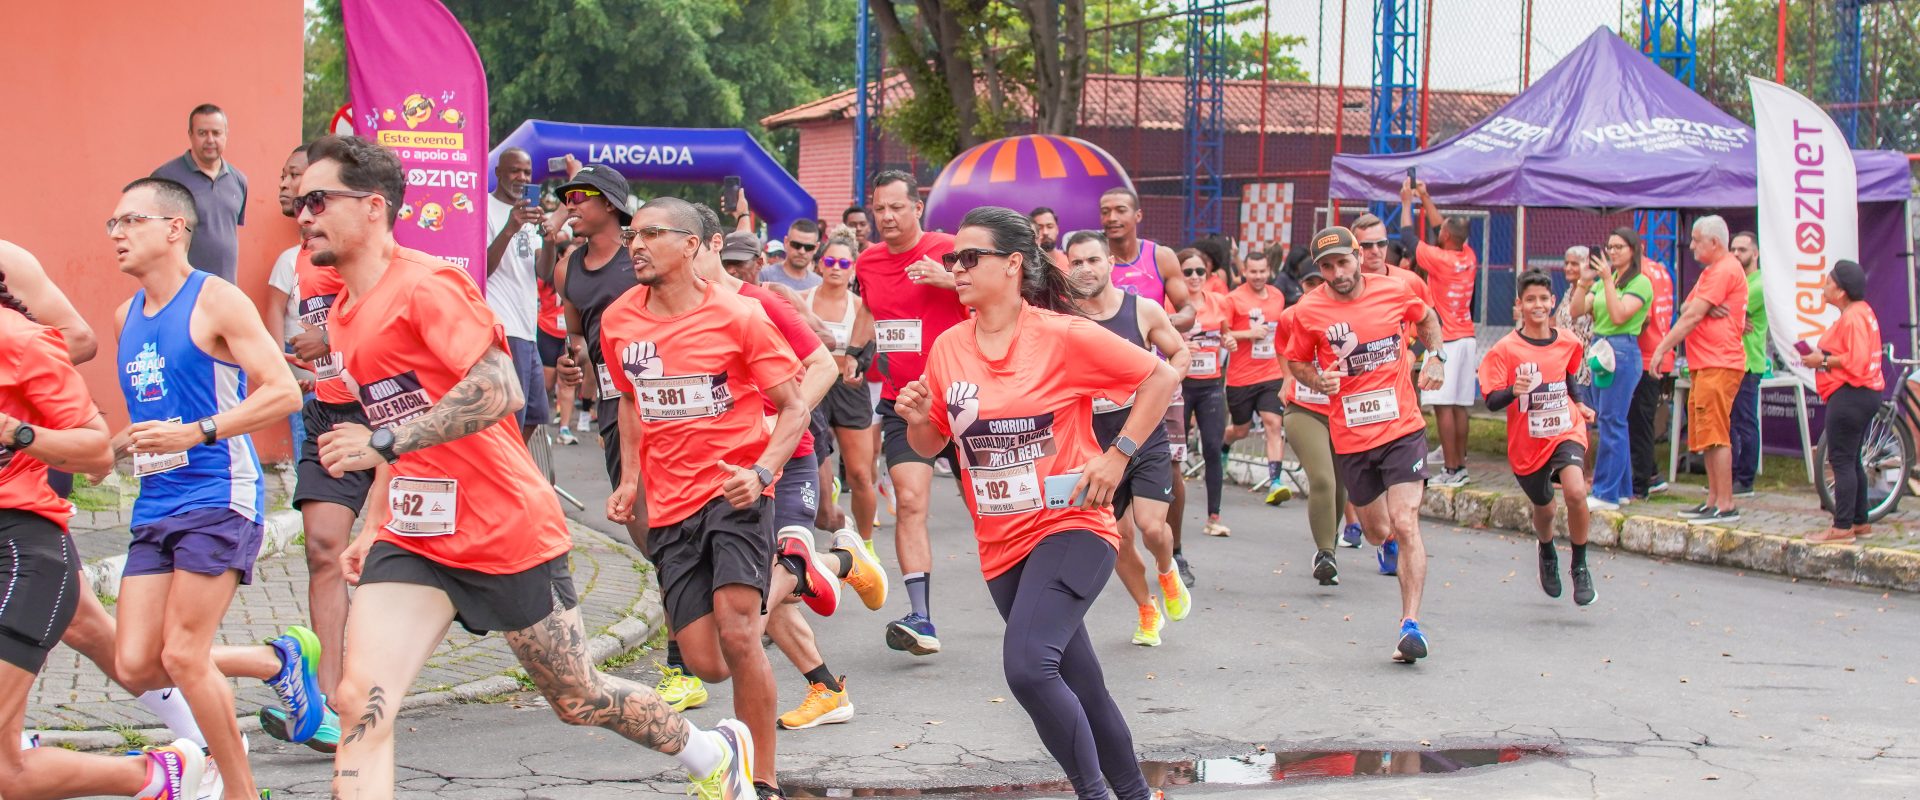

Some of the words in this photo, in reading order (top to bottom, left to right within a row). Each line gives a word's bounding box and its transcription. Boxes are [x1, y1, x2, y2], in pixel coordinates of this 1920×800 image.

[383, 133, 409, 143] Este
[413, 136, 457, 146] evento
[402, 150, 410, 159] o
[413, 150, 449, 162] apoio
[452, 150, 467, 161] da
[588, 144, 694, 165] LARGADA
[886, 328, 905, 341] 356
[657, 388, 686, 406] 381
[1359, 399, 1381, 414] 426
[989, 418, 1036, 434] CORRIDA
[1542, 416, 1560, 429] 239
[1017, 443, 1045, 461] REAL
[985, 480, 1011, 500] 192
[402, 493, 424, 516] 62
